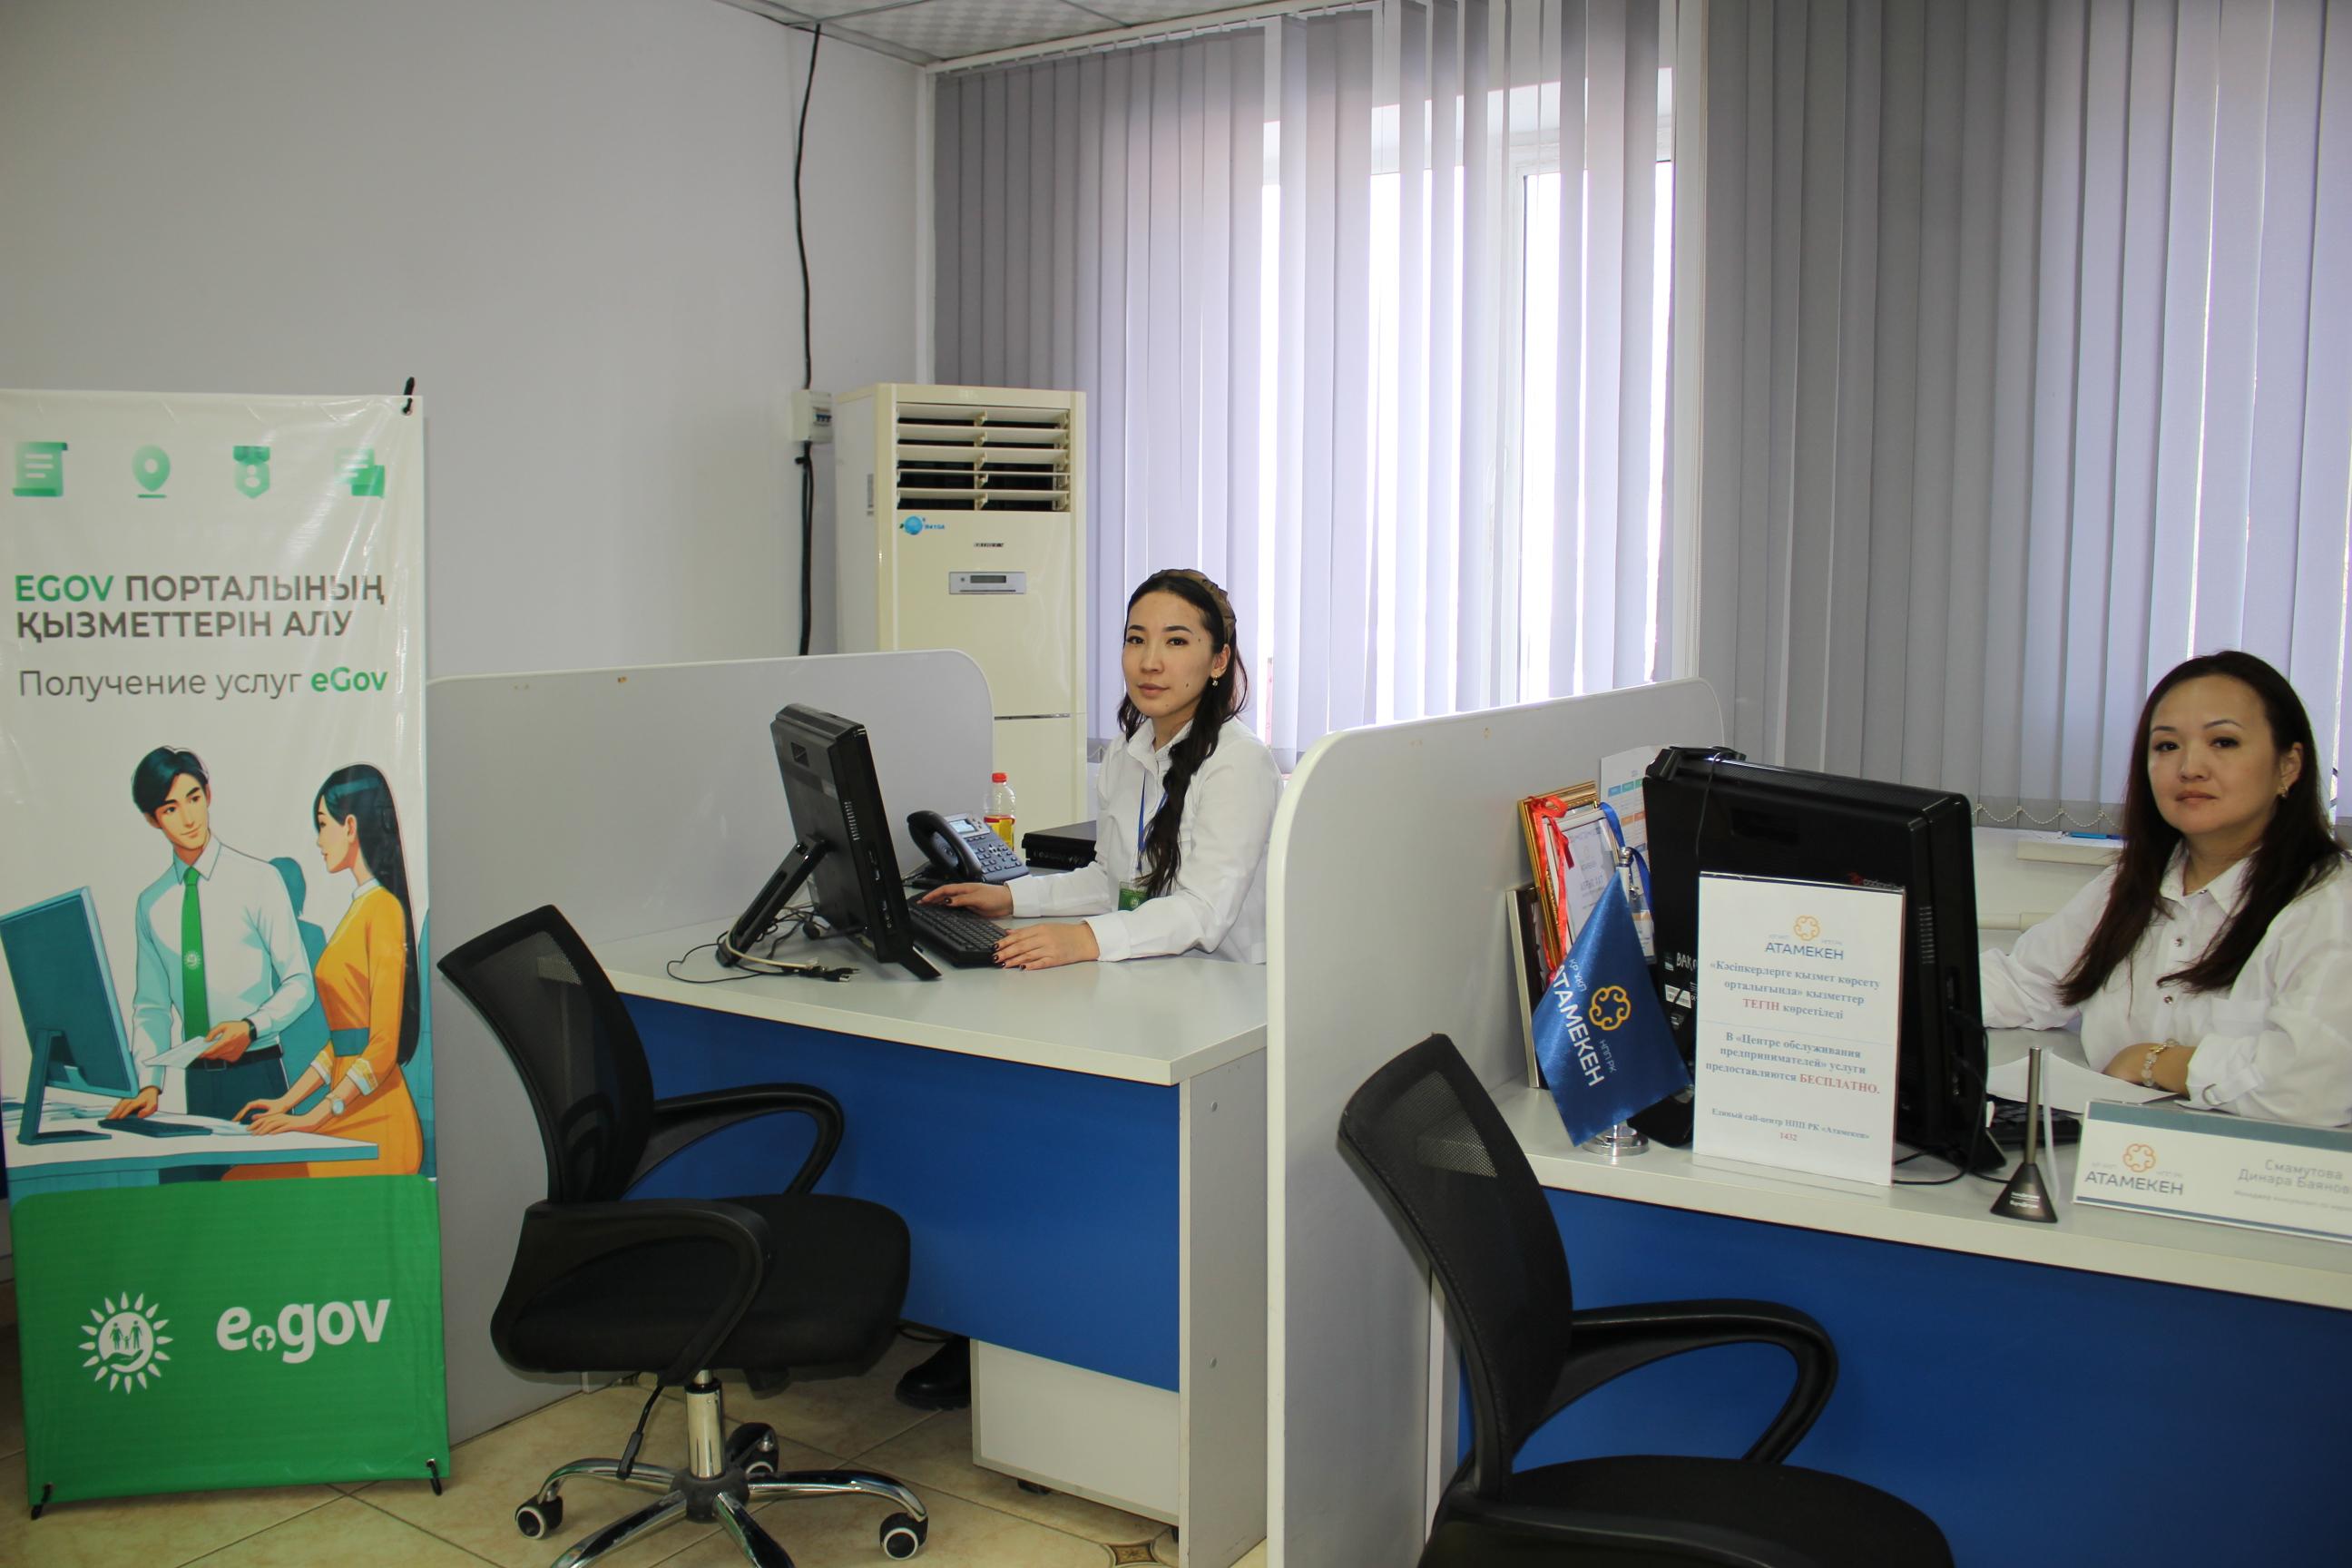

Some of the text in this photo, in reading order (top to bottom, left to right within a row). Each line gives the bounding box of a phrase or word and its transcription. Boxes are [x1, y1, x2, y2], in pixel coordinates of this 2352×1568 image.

[15, 574, 386, 605] EGOV ПОРТАЛЫНЫҢ
[17, 610, 352, 642] ҚЫЗМЕТТЕРІН АЛУ
[18, 666, 387, 702] Получение услуг eGov
[1765, 942, 1844, 960] АТАМЕКЕН
[1742, 998, 1779, 1010] ТЕГІН
[1726, 1032, 1734, 1042] В
[1783, 1041, 1861, 1059] обслуживания
[1706, 1062, 1880, 1094] предоставляются БЕСПЛАТНО.
[1829, 1062, 1866, 1074] услуги
[2085, 1171, 2183, 1195] АТАМЕКЕН
[2238, 1168, 2293, 1187] Динара
